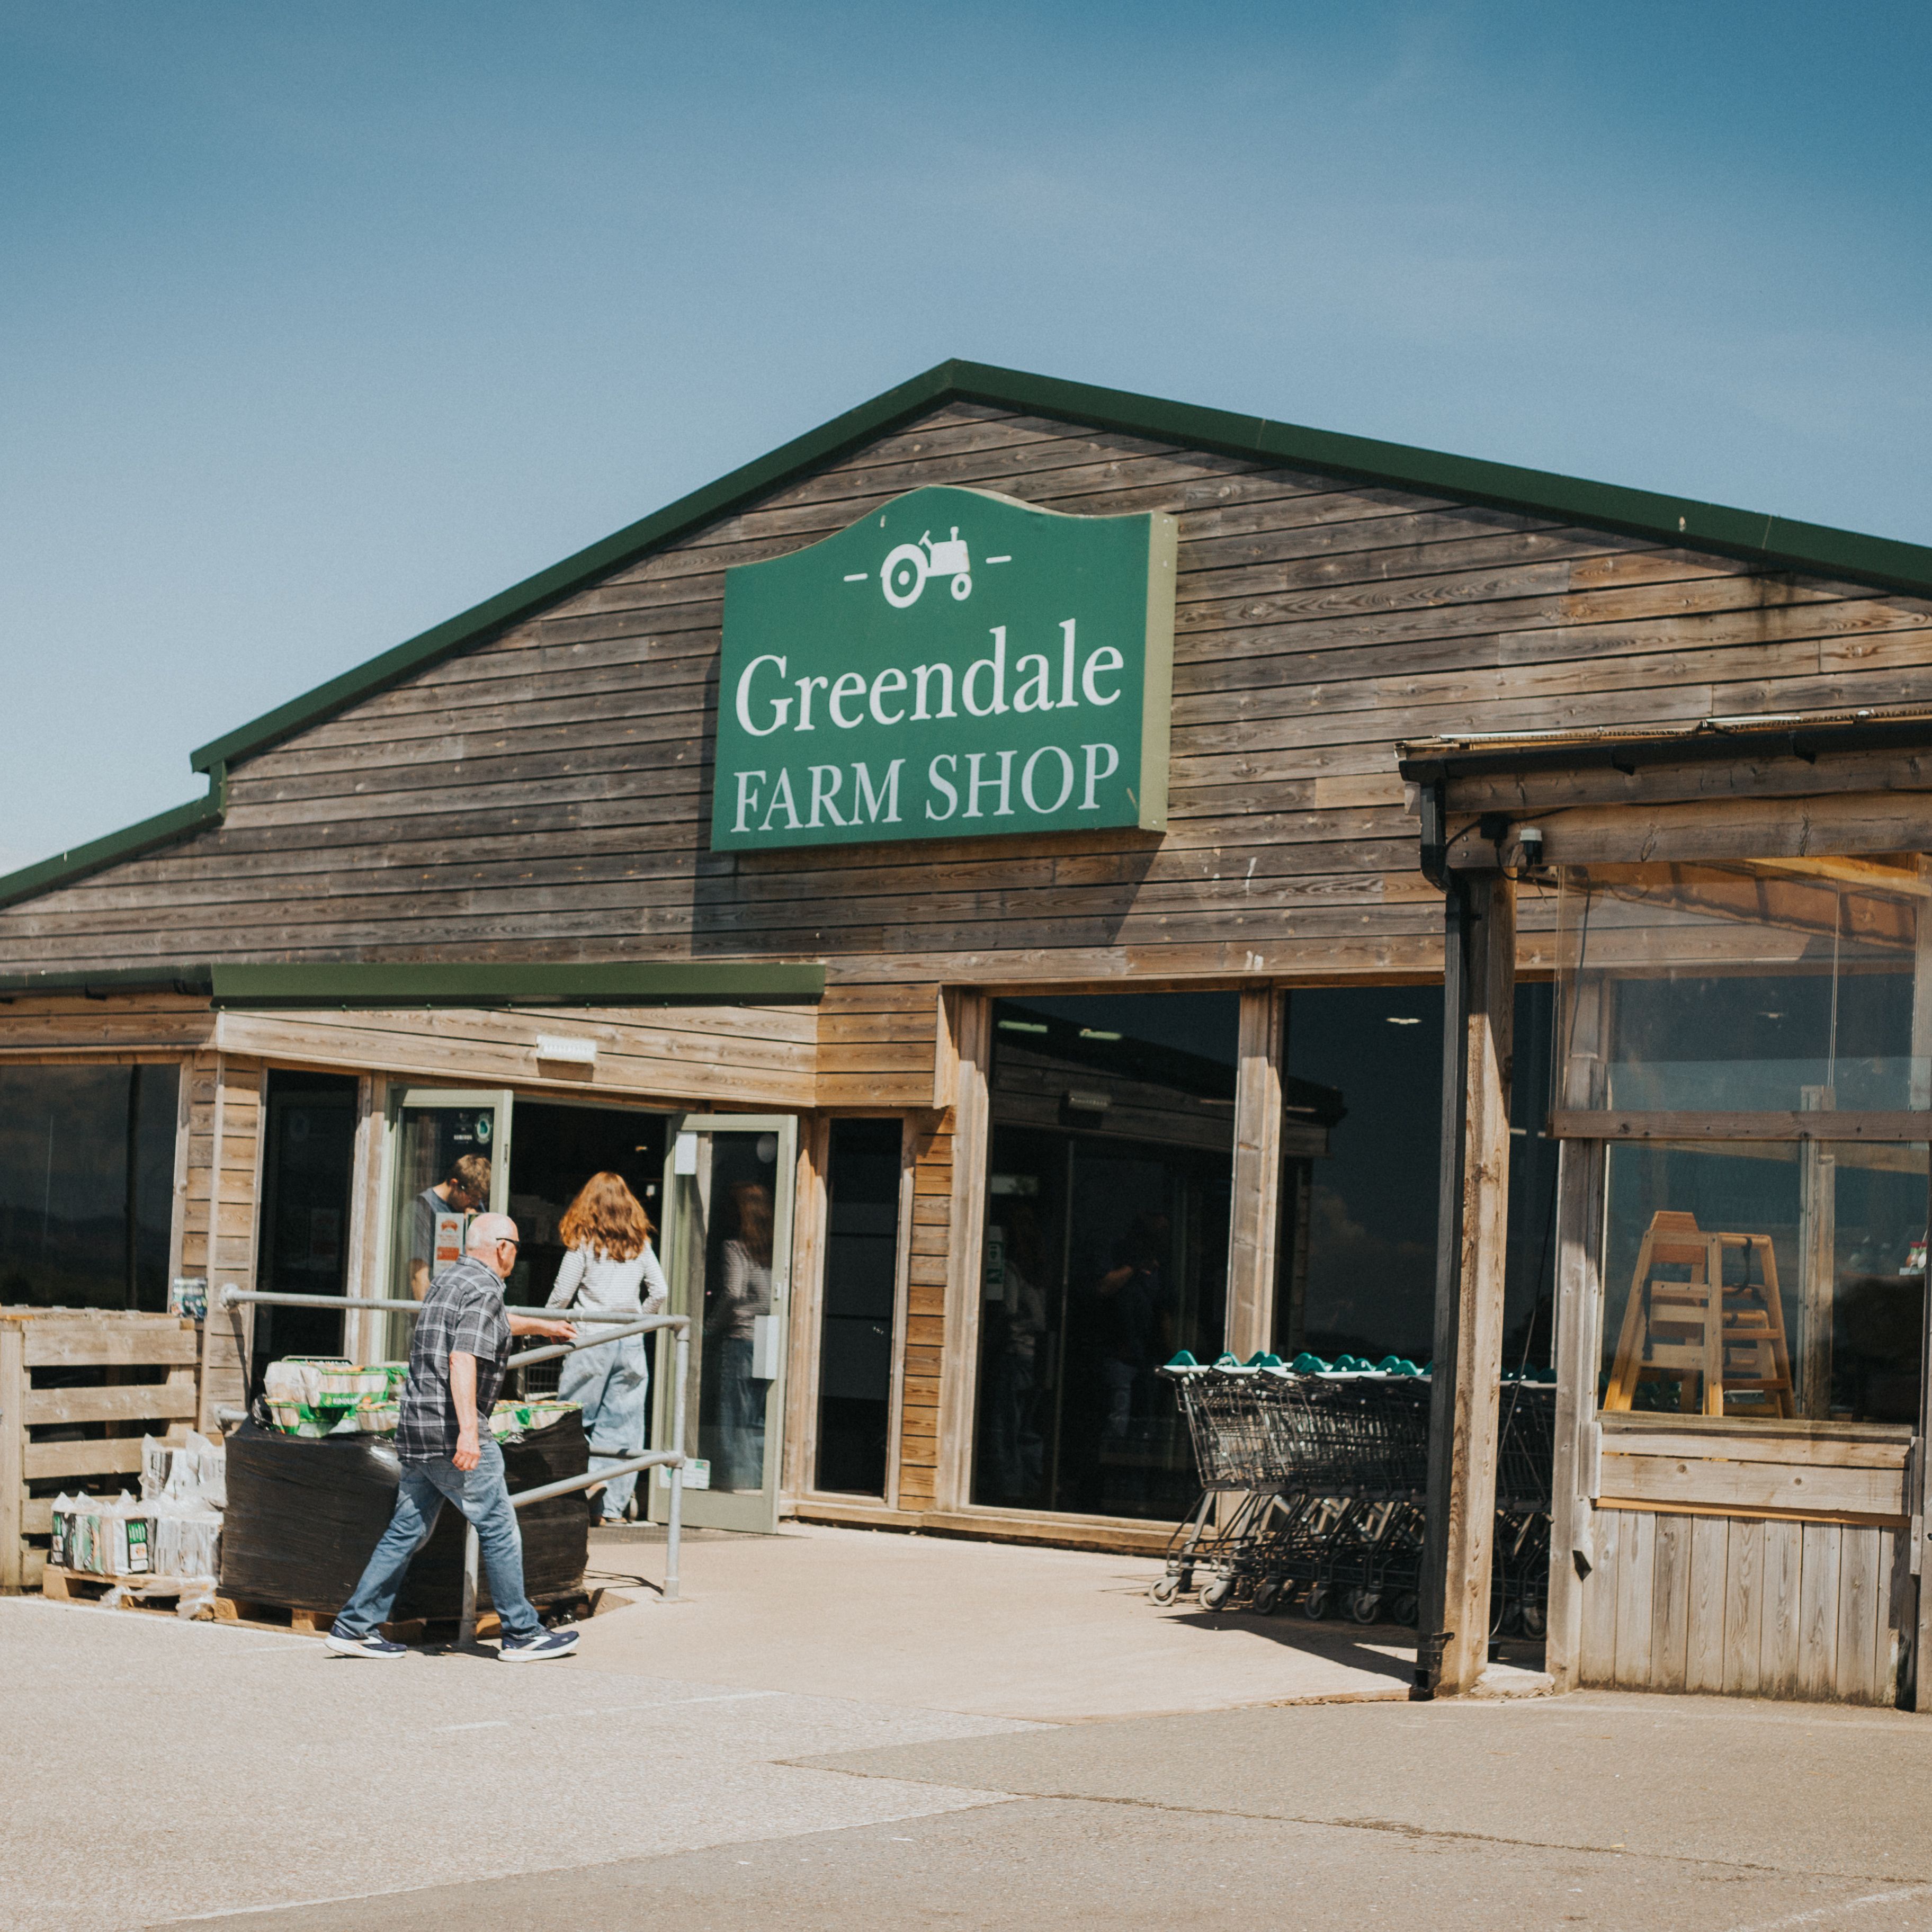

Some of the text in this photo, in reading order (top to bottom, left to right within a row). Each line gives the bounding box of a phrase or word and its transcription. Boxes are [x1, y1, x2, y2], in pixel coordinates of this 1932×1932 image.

[736, 618, 1123, 736] Greendale
[731, 744, 1119, 832] FARM SHOP
